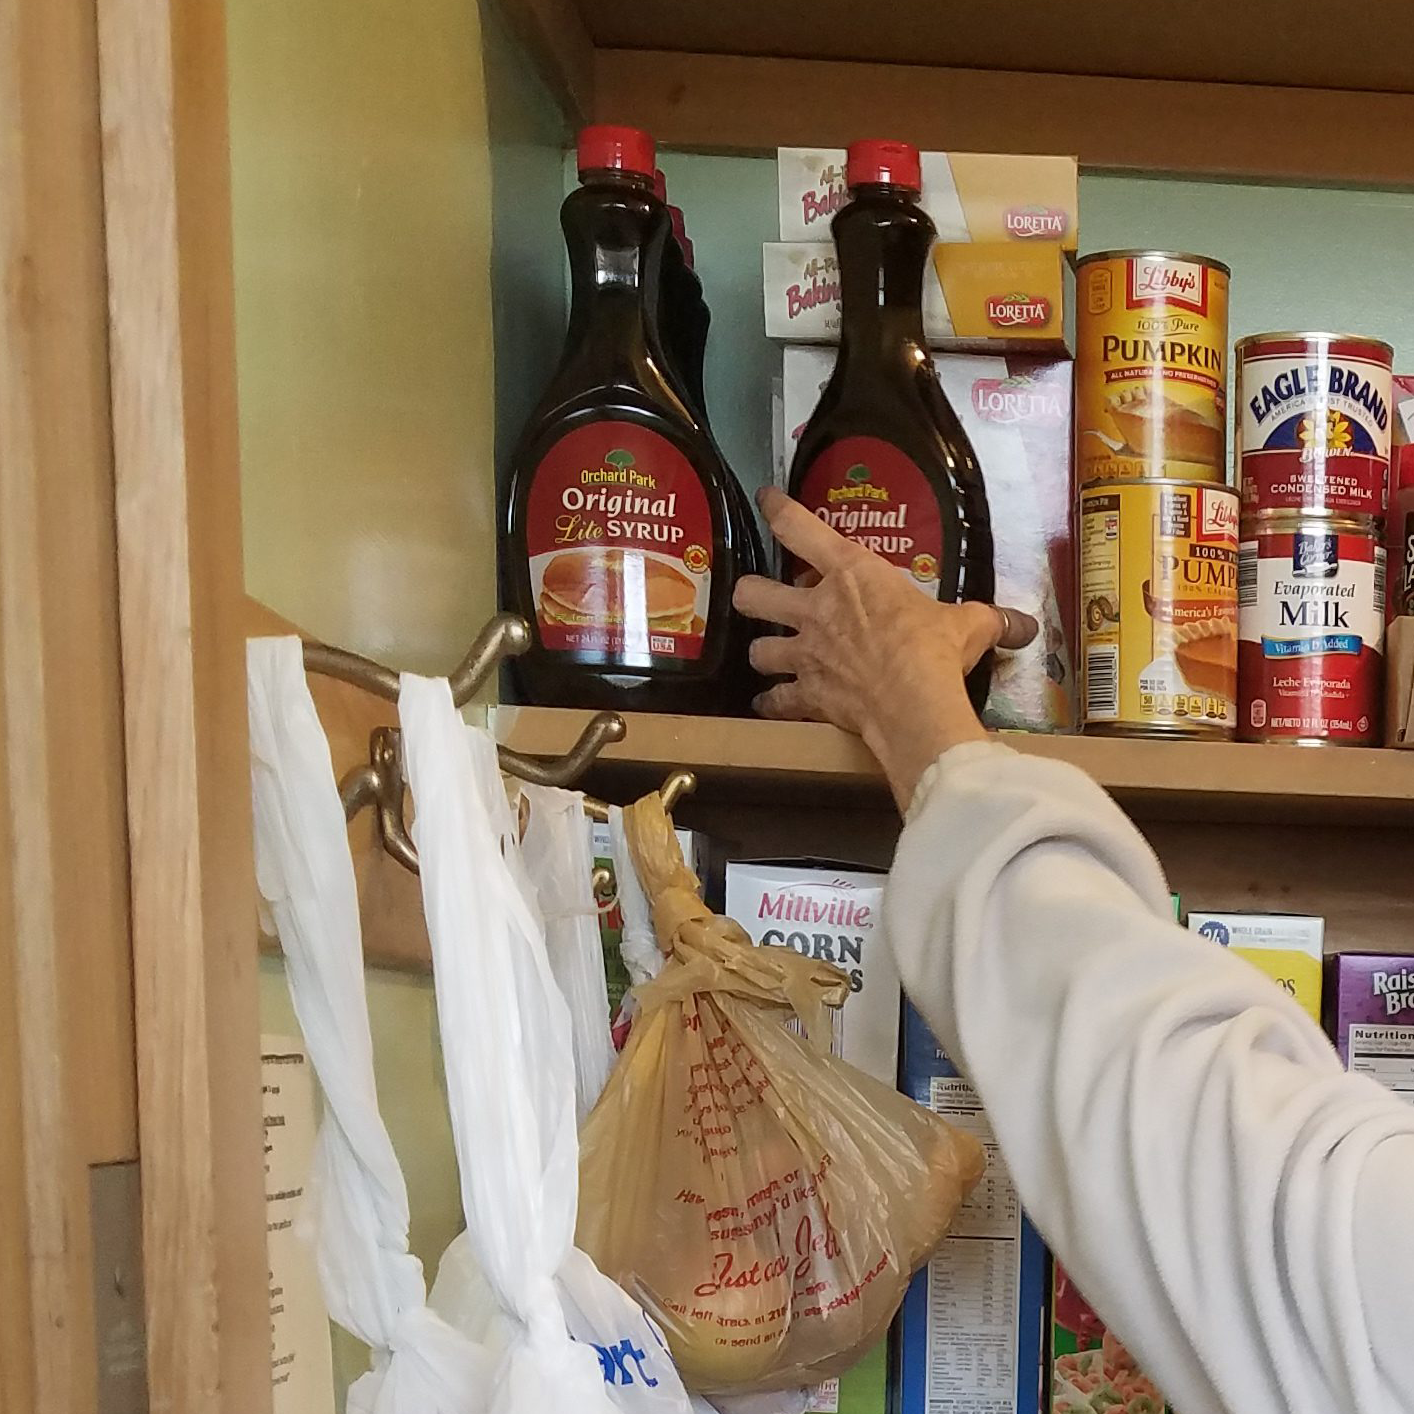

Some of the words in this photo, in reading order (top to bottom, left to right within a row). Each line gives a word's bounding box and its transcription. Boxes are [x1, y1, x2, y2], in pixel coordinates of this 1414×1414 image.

[1007, 213, 1064, 236] LORETTA
[1139, 264, 1196, 293] Libby's
[786, 277, 842, 319] Bakin
[989, 302, 1046, 326] LORETTA
[1171, 317, 1200, 332] Pure
[1102, 335, 1223, 372] PUMPKIN
[1124, 369, 1158, 378] NATURA
[977, 388, 1064, 423] LORETTA
[1249, 364, 1319, 425] EAGLE
[1327, 364, 1389, 432] BRAND
[1271, 400, 1307, 422] AMERICA
[580, 469, 627, 485] Orchard
[629, 469, 657, 490] Park
[1290, 474, 1358, 486] SWETENED
[562, 486, 677, 518] Original
[864, 483, 889, 500] Park
[1270, 483, 1347, 496] CONDENSED
[1349, 486, 1373, 500] MILK
[554, 513, 605, 544] Lite
[606, 519, 685, 544] SYRUP
[814, 503, 908, 533] Original
[1195, 546, 1226, 560] 100%
[1158, 554, 1238, 590] PUMP
[1273, 580, 1356, 600] Evaporated
[1279, 600, 1350, 628] Milk
[652, 643, 674, 652] USA
[1272, 676, 1301, 687] Leche
[757, 892, 871, 928] Millville
[762, 929, 864, 965] CORN
[937, 1082, 975, 1093] Nutriti
[730, 1335, 761, 1348] send
